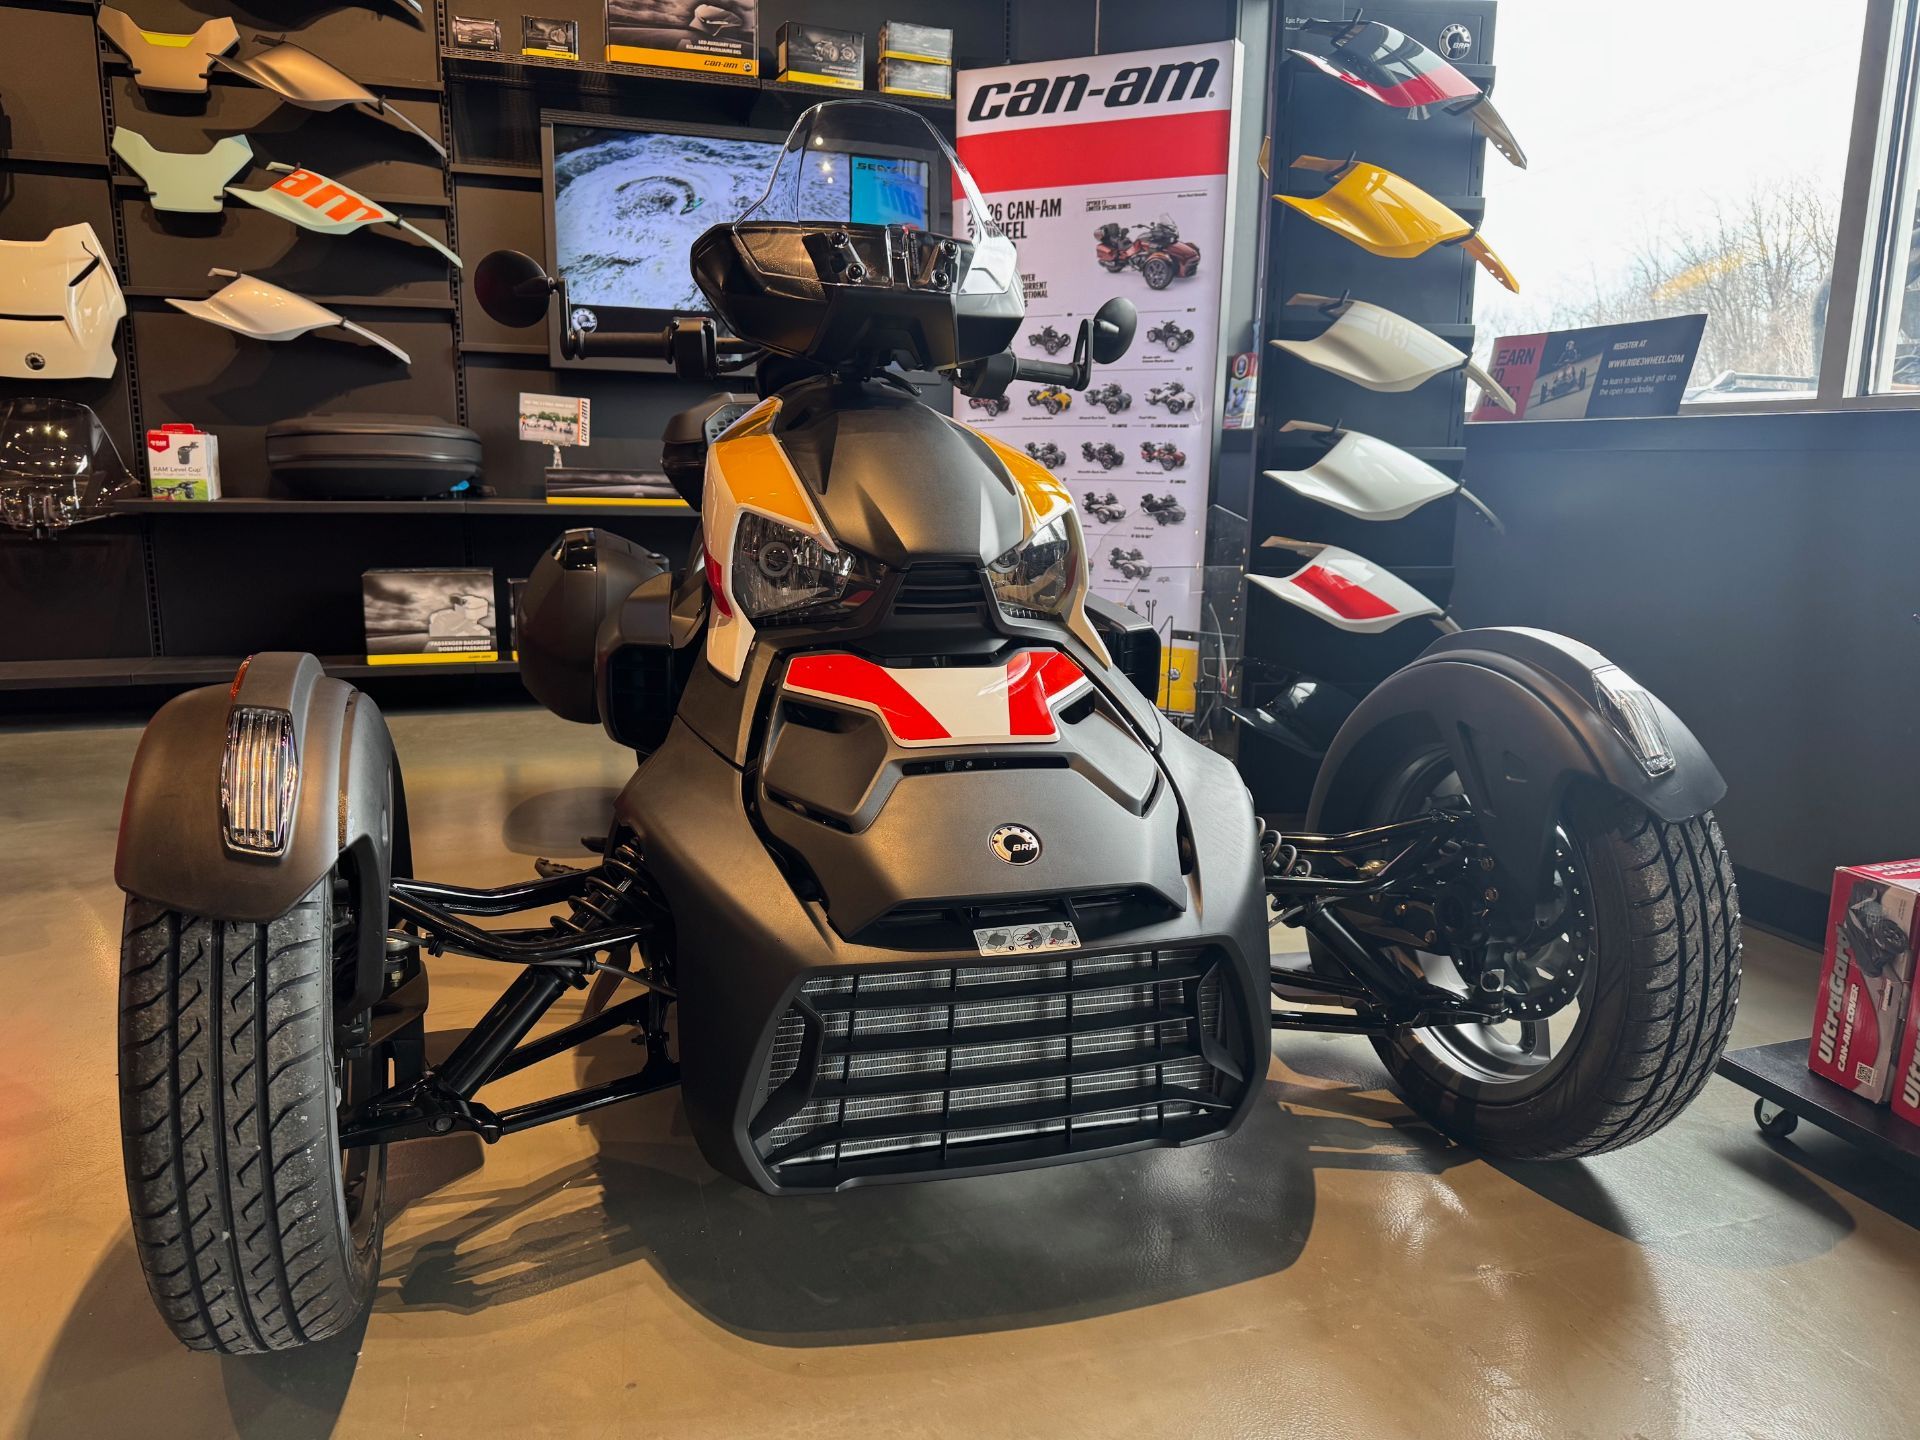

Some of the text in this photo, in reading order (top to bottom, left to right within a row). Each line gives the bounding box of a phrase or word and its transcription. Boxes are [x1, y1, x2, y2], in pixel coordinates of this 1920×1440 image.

[704, 60, 738, 69] can-am
[968, 57, 1220, 122] can-am
[1007, 198, 1062, 221] CAN-AM
[1818, 922, 1850, 1065] UltraGard
[1838, 983, 1859, 1072] CAN-AM COVER
